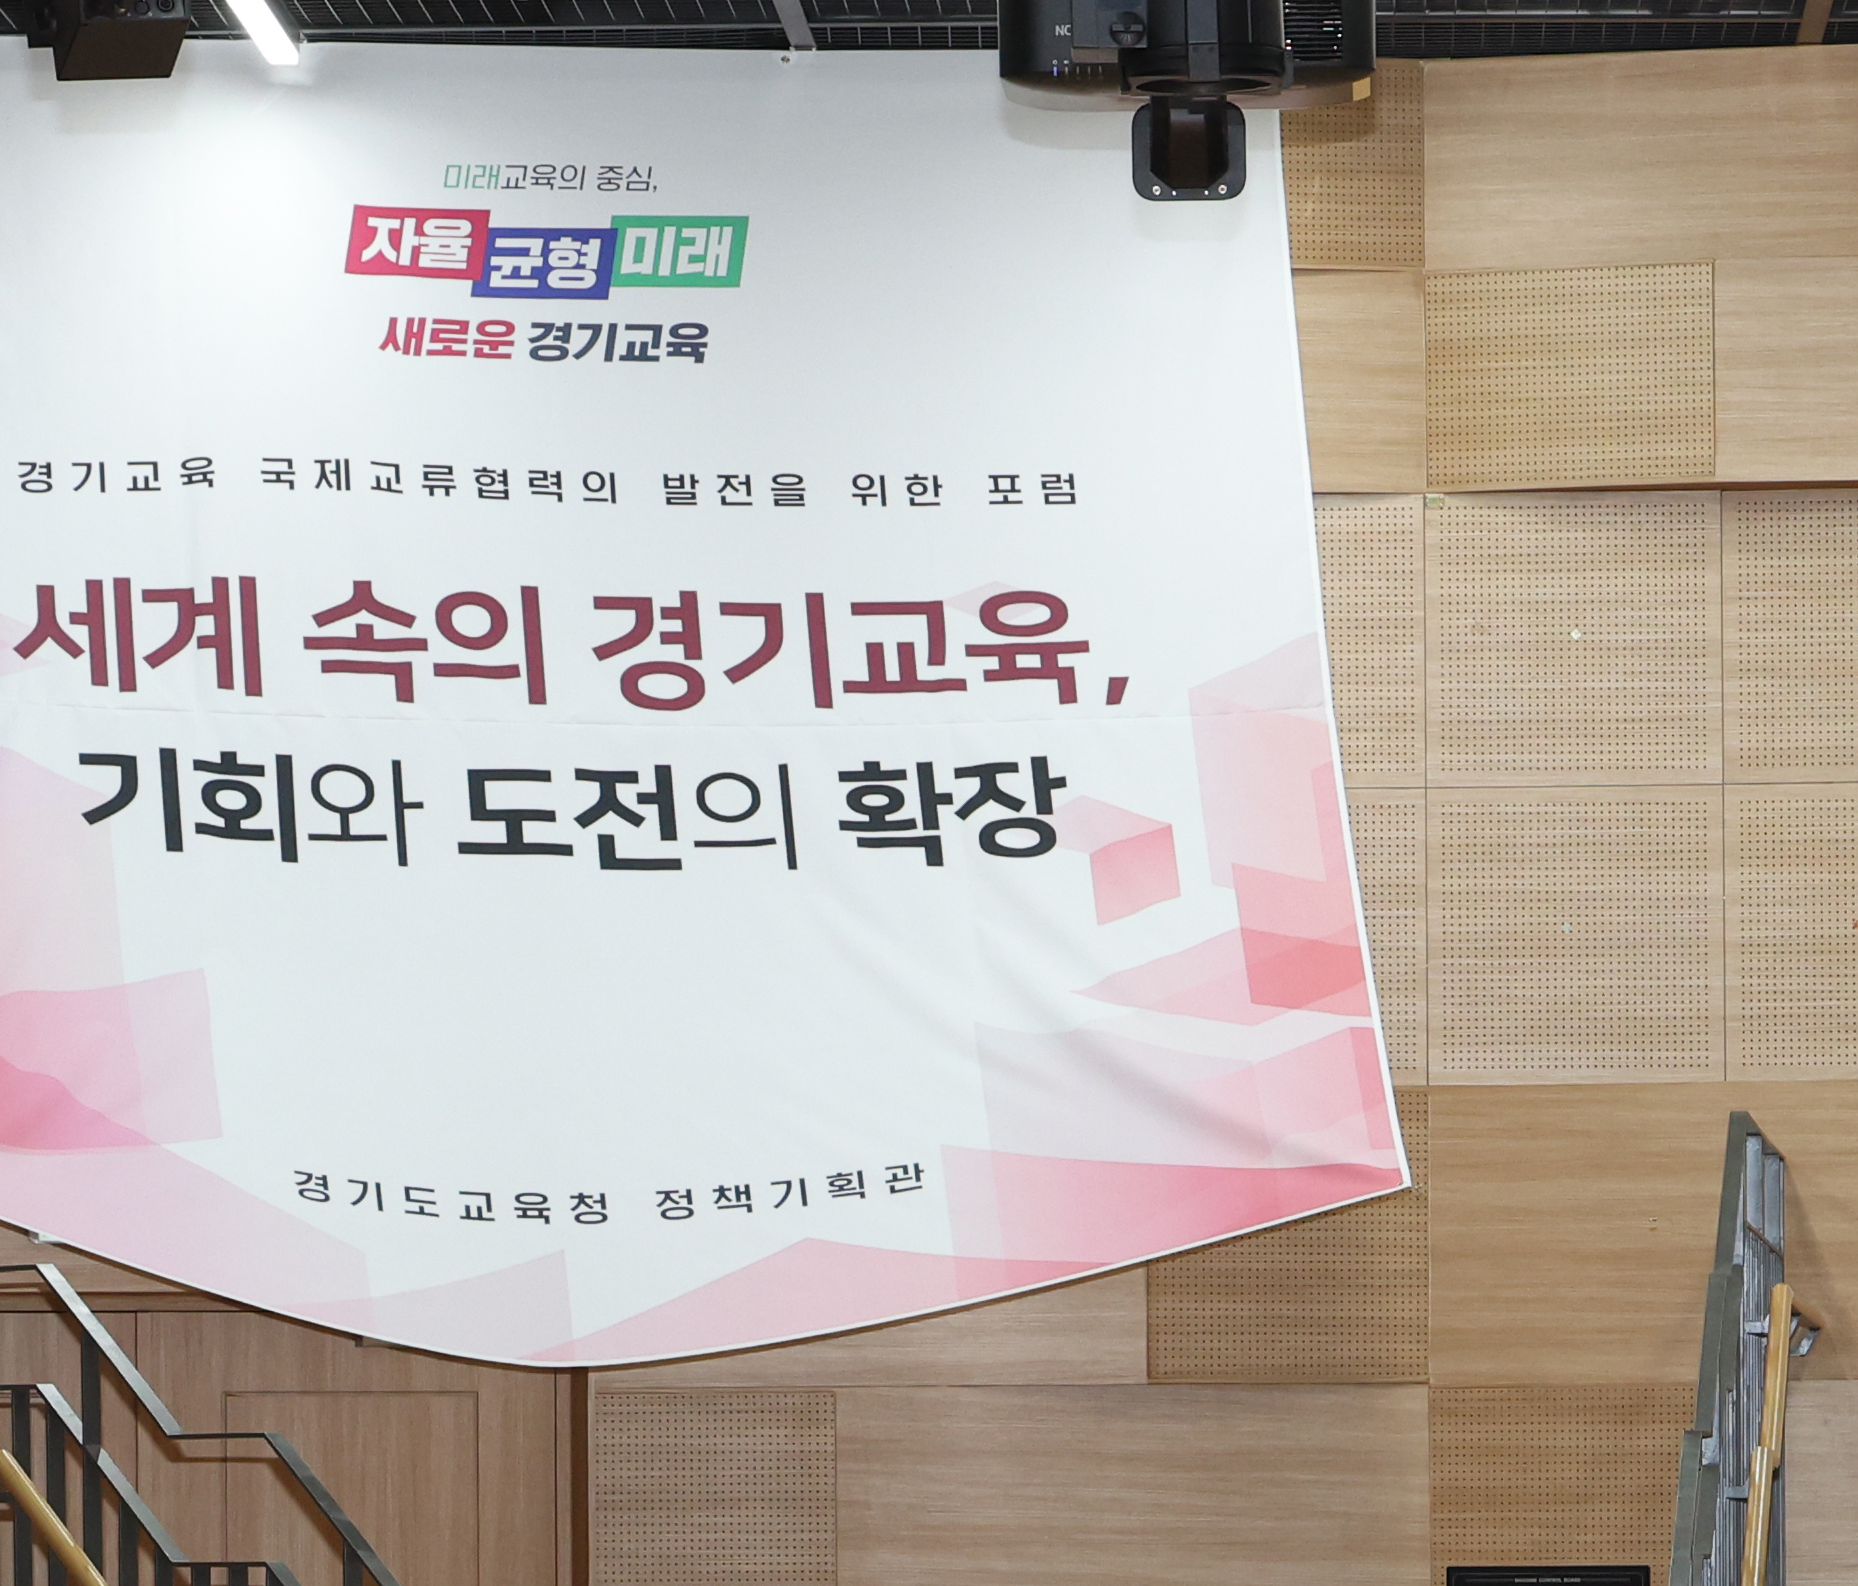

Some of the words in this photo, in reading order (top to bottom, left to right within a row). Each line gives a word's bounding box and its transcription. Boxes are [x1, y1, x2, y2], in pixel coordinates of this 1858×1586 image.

[442, 162, 588, 193] 미래교육의
[595, 164, 659, 197] 중심,
[359, 215, 474, 271] 자율
[487, 235, 603, 291] 균형
[618, 224, 735, 278] 미래
[377, 315, 517, 361] 새로운
[526, 320, 710, 365] 경기교육
[16, 455, 216, 495] 경기교육
[259, 456, 618, 506] 국제교류협력의
[661, 472, 807, 508] 발전을
[850, 472, 944, 508] 위한
[986, 471, 1078, 506] 포럼
[11, 574, 265, 699] 세계
[301, 579, 549, 707] 속의
[590, 589, 1131, 713] 경기교육,
[77, 746, 426, 869] 기회와
[456, 762, 799, 873] 도전의
[836, 754, 1069, 868] 확장
[292, 1169, 610, 1226] 경기도교육청
[654, 1161, 926, 1222] 정책기획관
